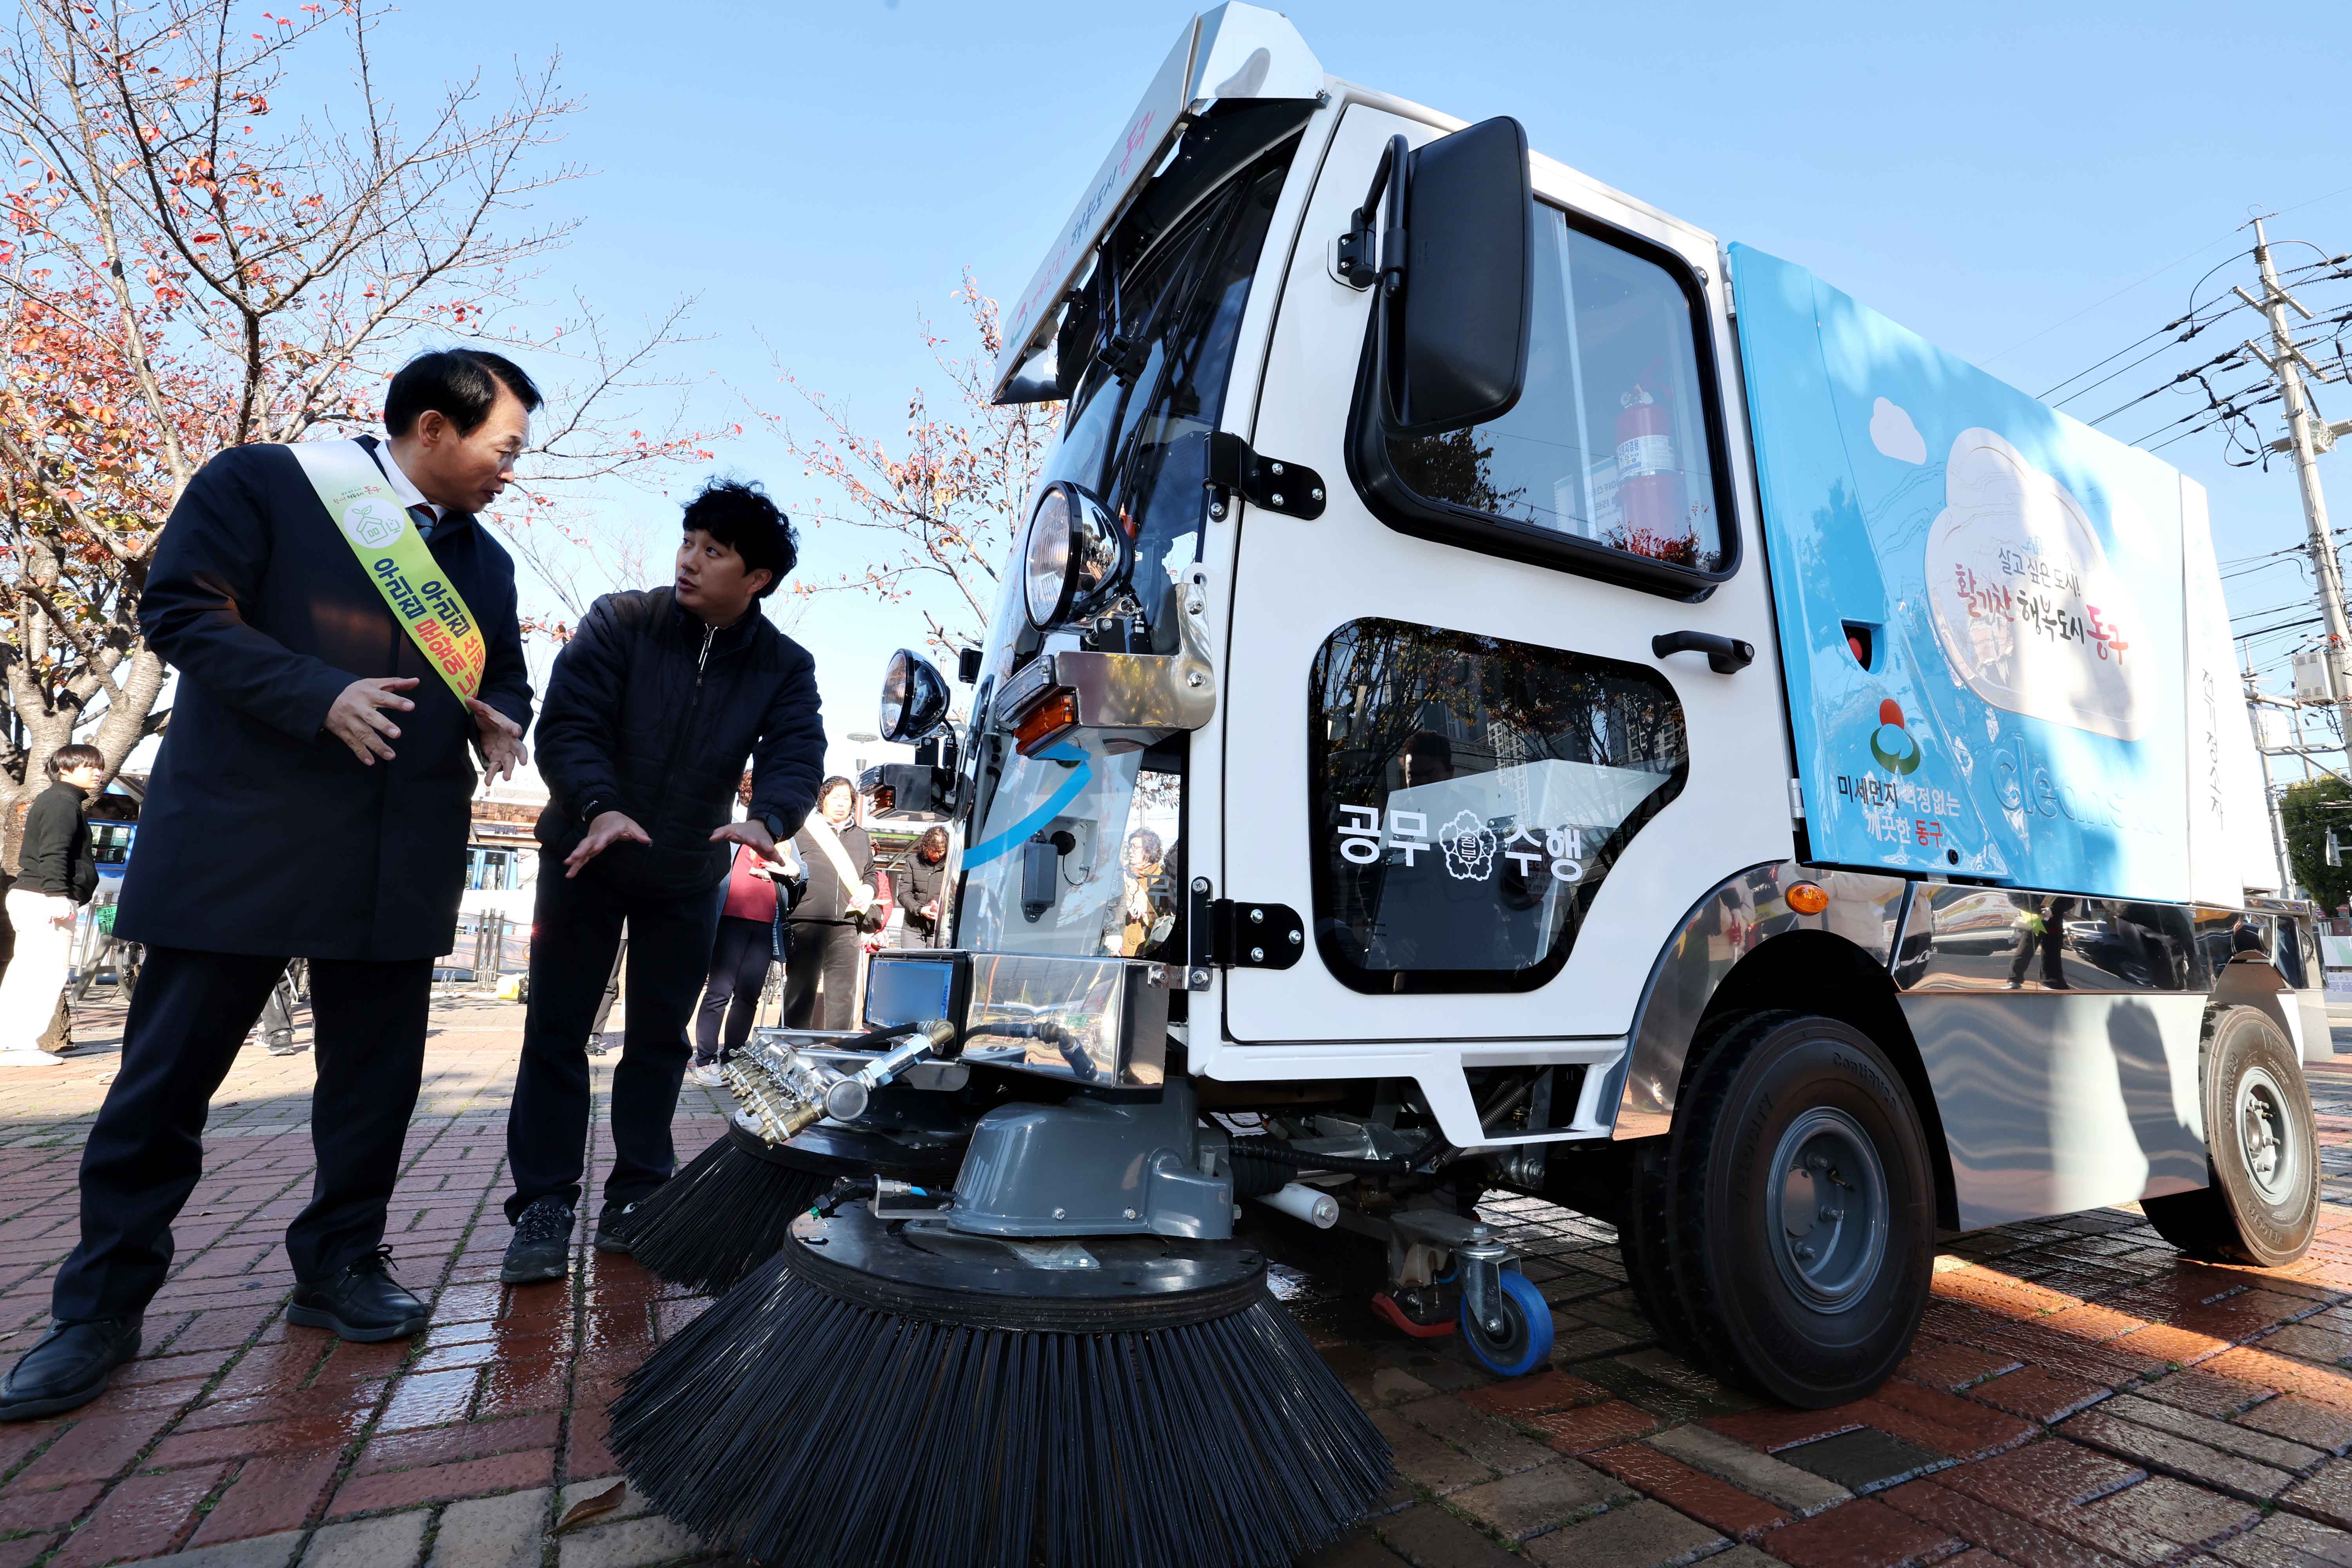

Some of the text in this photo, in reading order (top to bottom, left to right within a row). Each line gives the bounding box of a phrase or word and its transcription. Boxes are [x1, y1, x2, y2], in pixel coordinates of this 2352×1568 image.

[1071, 165, 1118, 247] 행복도시
[1119, 109, 1157, 177] 동구
[364, 486, 382, 494] 동구
[1999, 547, 2025, 575] 살고
[2027, 558, 2051, 588] 싶은
[2054, 568, 2080, 597] 도시!
[374, 558, 428, 620] 우리집
[414, 618, 468, 676] 문앞에
[421, 581, 471, 639] 우리집
[1955, 562, 2129, 666] 활기찬 행복도시 동구
[1837, 775, 1960, 817] 미세먼지 걱정없는
[1338, 804, 1583, 882] 공무 수행
[1461, 836, 1477, 860] 정부
[1867, 813, 1943, 847] 깨끗한 동구
